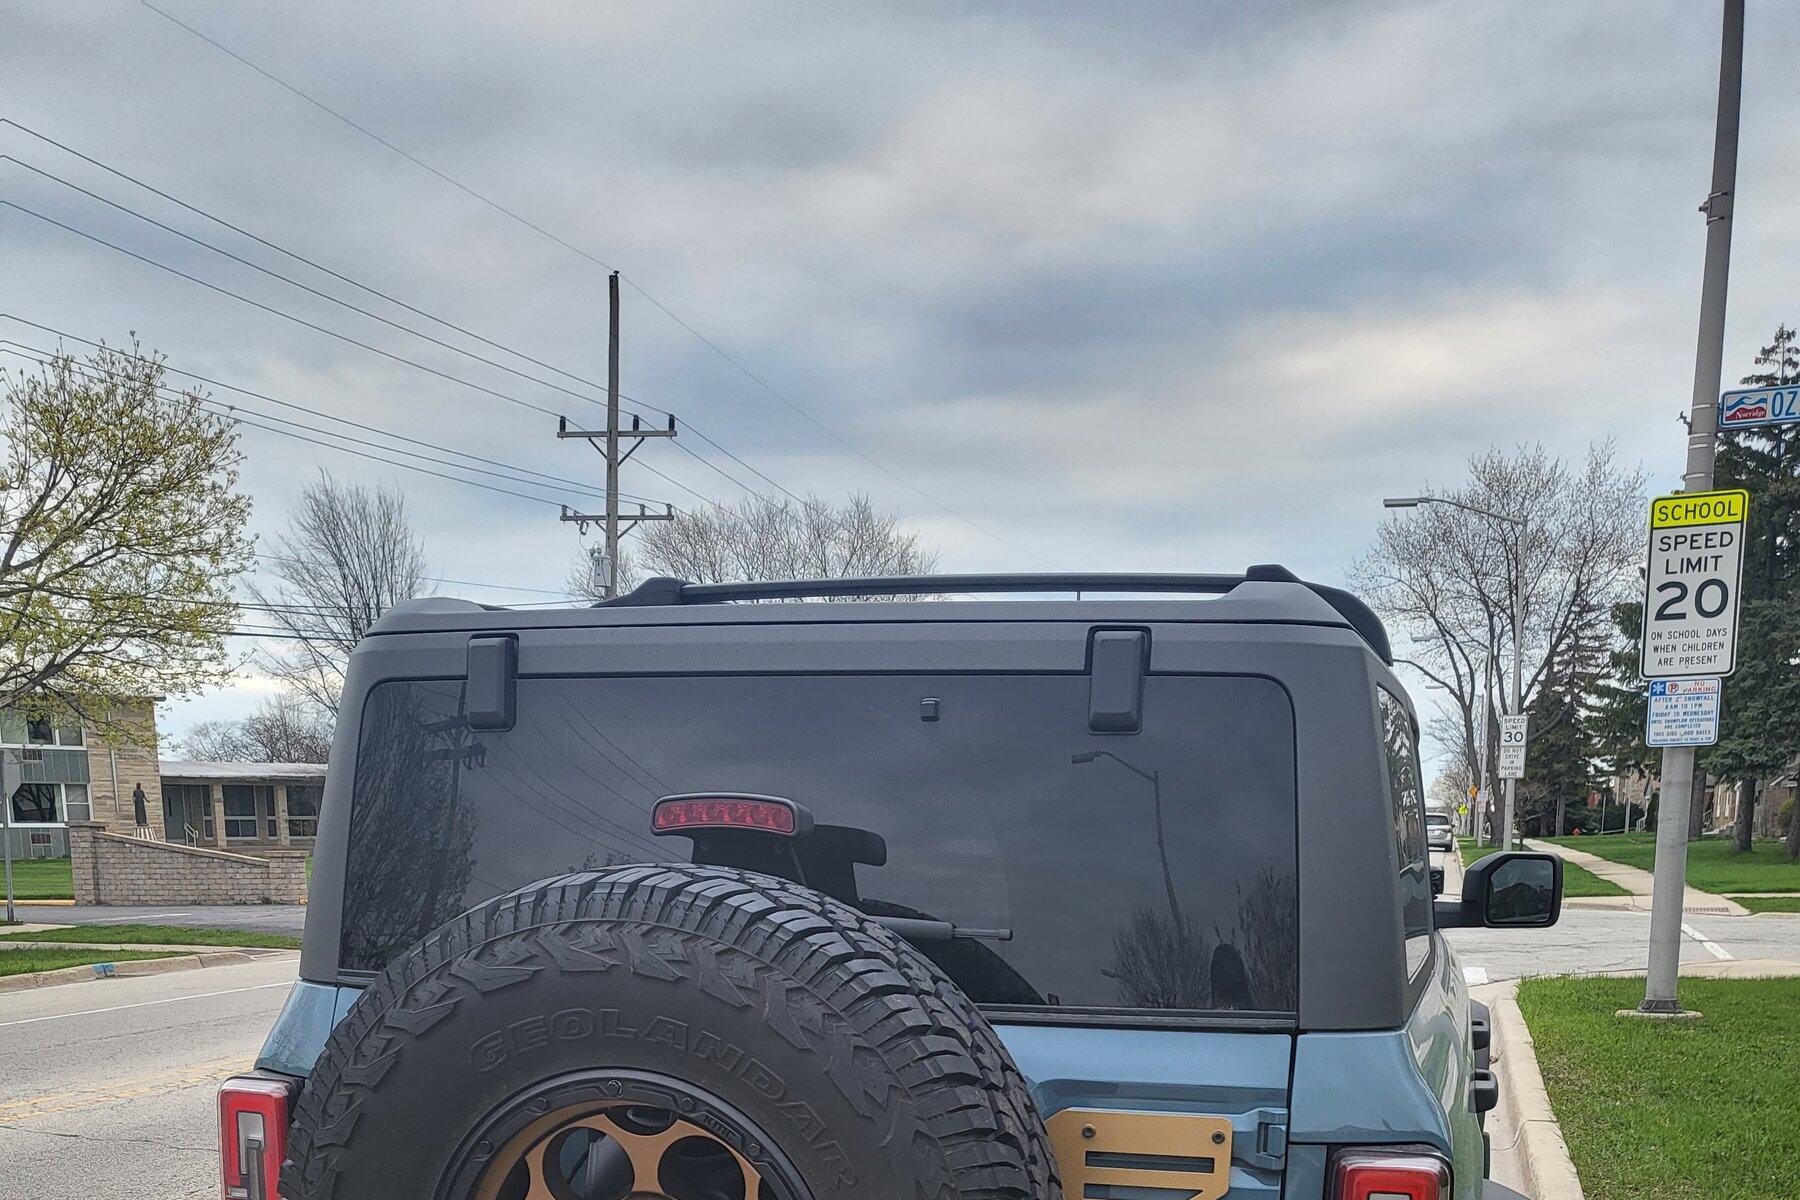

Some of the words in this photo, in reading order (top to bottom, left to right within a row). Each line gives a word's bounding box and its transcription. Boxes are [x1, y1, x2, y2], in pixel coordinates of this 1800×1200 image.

[1772, 391, 1800, 418] OZ
[1658, 500, 1738, 522] SCHOOL
[1658, 531, 1734, 552] SPEED
[1665, 556, 1723, 575] LIMIT
[1654, 578, 1728, 621] 20
[1651, 632, 1662, 640] ON
[1668, 629, 1701, 639] SCHOOL
[1706, 628, 1727, 637] DAYS
[1653, 644, 1676, 653] WHEN
[1682, 641, 1724, 652] CHILDREN
[1657, 657, 1674, 666] ARE
[1679, 655, 1717, 665] PRESENT
[1504, 732, 1523, 742] 30
[468, 1007, 859, 1191] GEOLANDAR
